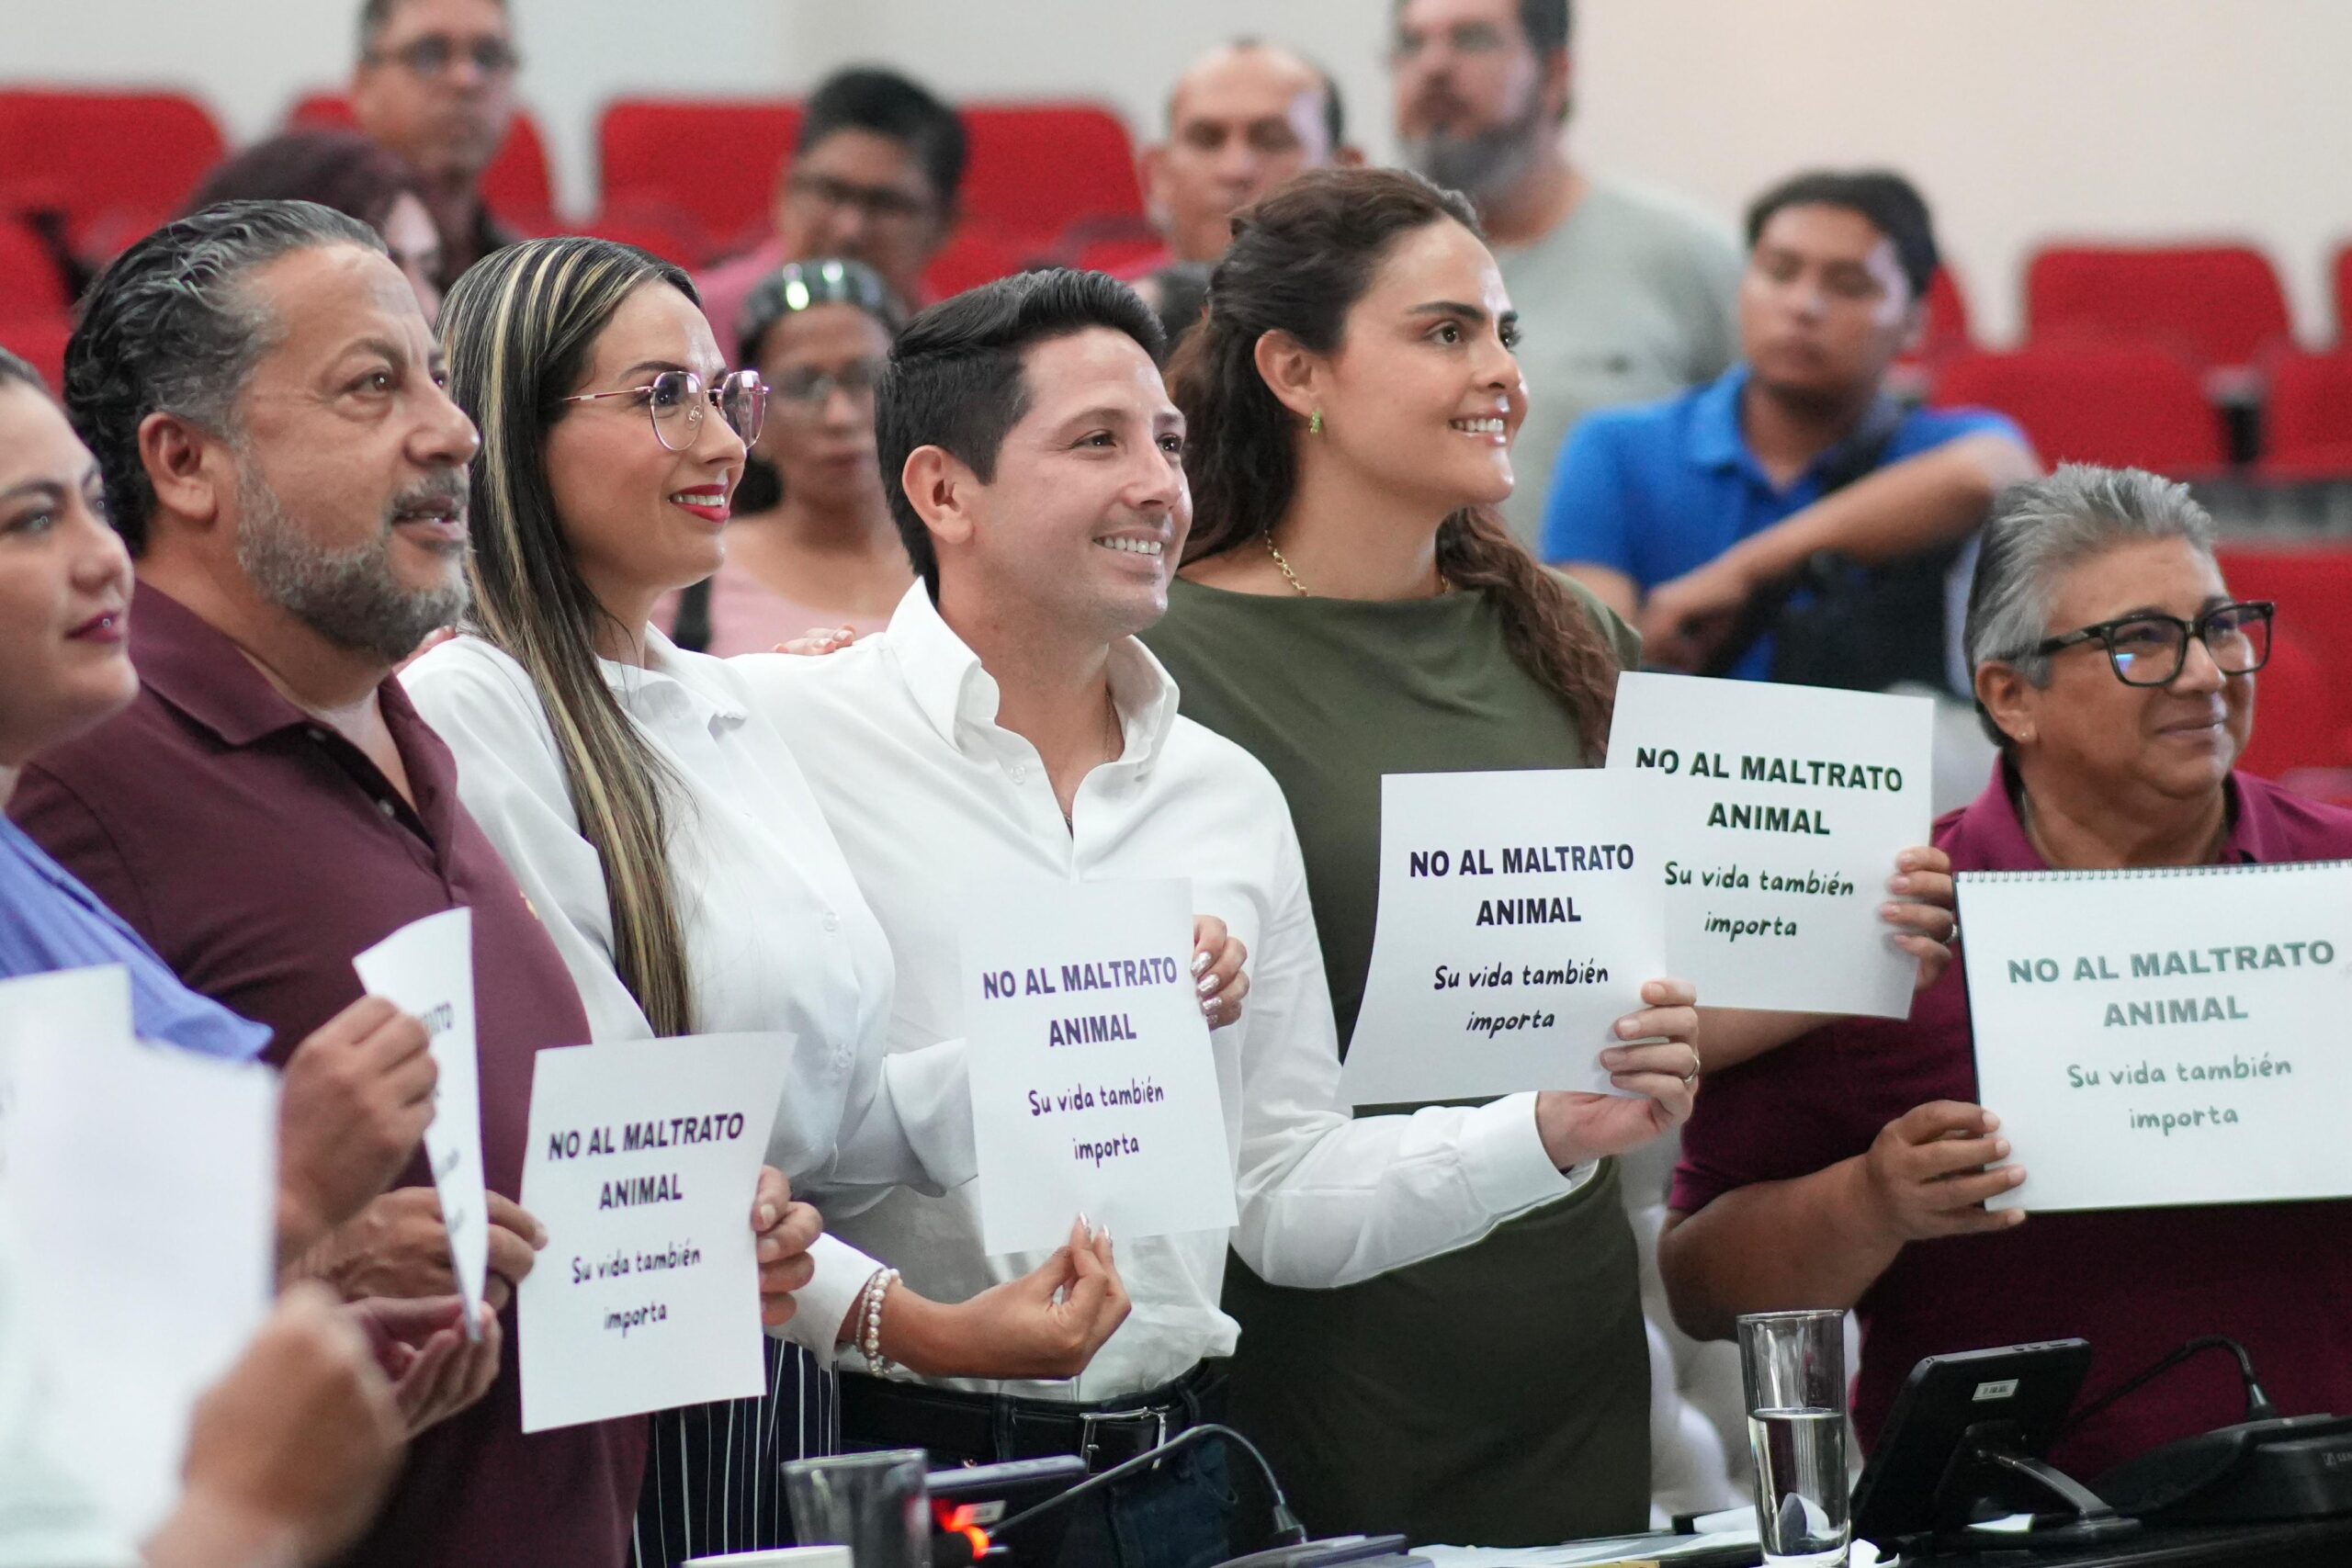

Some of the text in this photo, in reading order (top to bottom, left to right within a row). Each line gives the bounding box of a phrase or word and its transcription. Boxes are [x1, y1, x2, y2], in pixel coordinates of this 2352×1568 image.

[1635, 747, 1904, 793] NO AL MALTRATO
[1707, 801, 1831, 835] ANIMAL
[1409, 843, 1634, 877] NO AL MALTRATO
[1664, 861, 1854, 896] Su vida también
[1476, 897, 1582, 927] ANIMAL
[1704, 910, 1798, 943] importa
[983, 956, 1177, 999] NO AL MALTRATO
[1433, 957, 1609, 990] Su vida también
[2007, 940, 2335, 984] NO AL MALTRATO
[1465, 1010, 1555, 1040] importa
[2103, 996, 2249, 1028] ANIMAL
[1049, 1013, 1137, 1047] ANIMAL
[2066, 1053, 2292, 1089] Su vida también
[1028, 1076, 1164, 1117] Su vida también
[548, 1112, 745, 1161] NO AL MALTRATO
[2129, 1106, 2239, 1137] importa
[1072, 1133, 1140, 1169] importa
[599, 1172, 684, 1211] ANIMAL
[571, 1237, 701, 1284] Su vida también
[604, 1302, 668, 1338] importa
